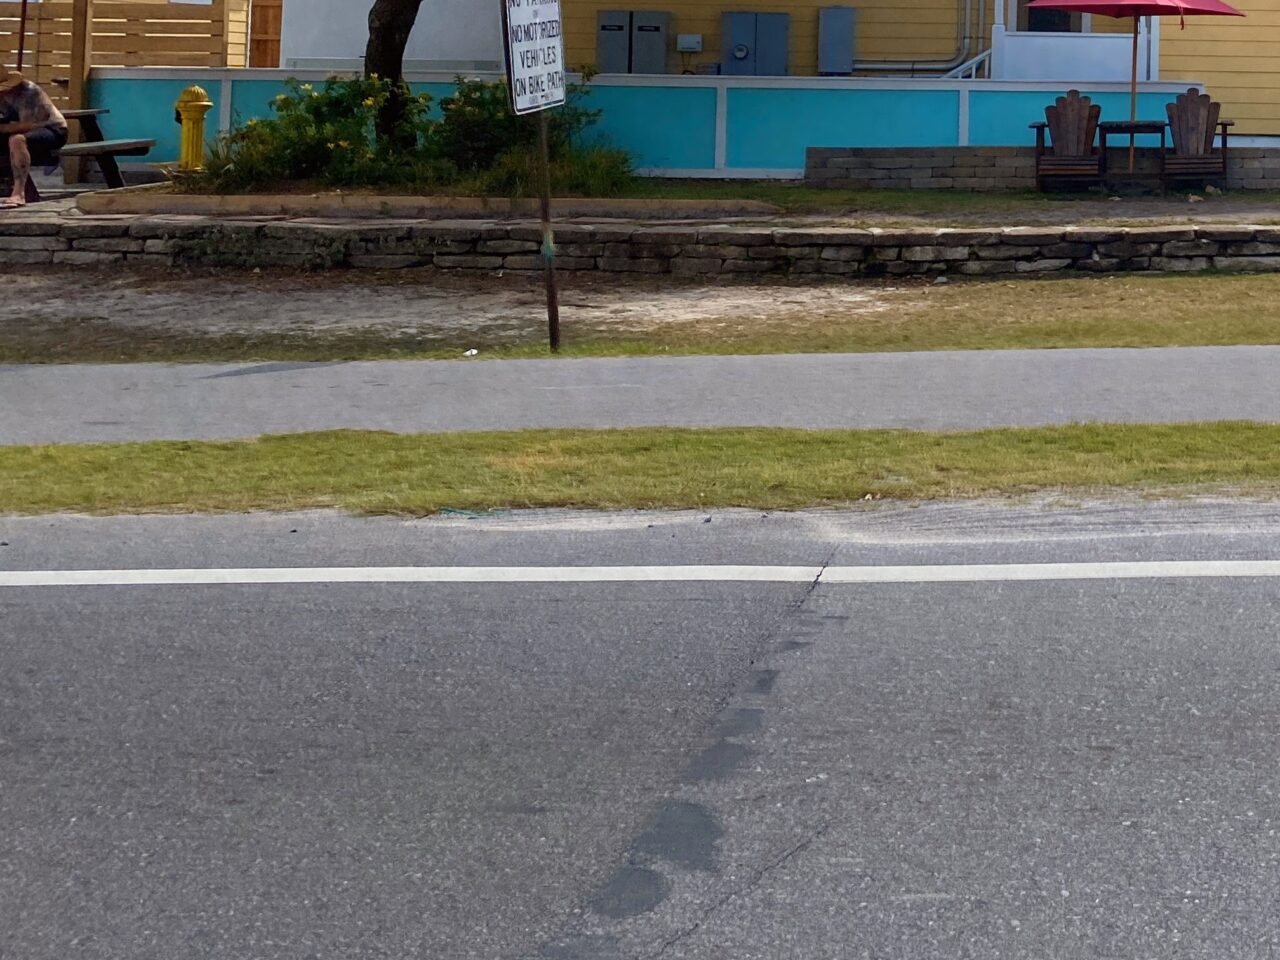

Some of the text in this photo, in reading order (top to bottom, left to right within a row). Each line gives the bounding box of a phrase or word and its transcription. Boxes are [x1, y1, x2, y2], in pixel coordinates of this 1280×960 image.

[512, 20, 560, 43] NO MOTORIZED
[516, 71, 564, 97] ON BIKE PATH
